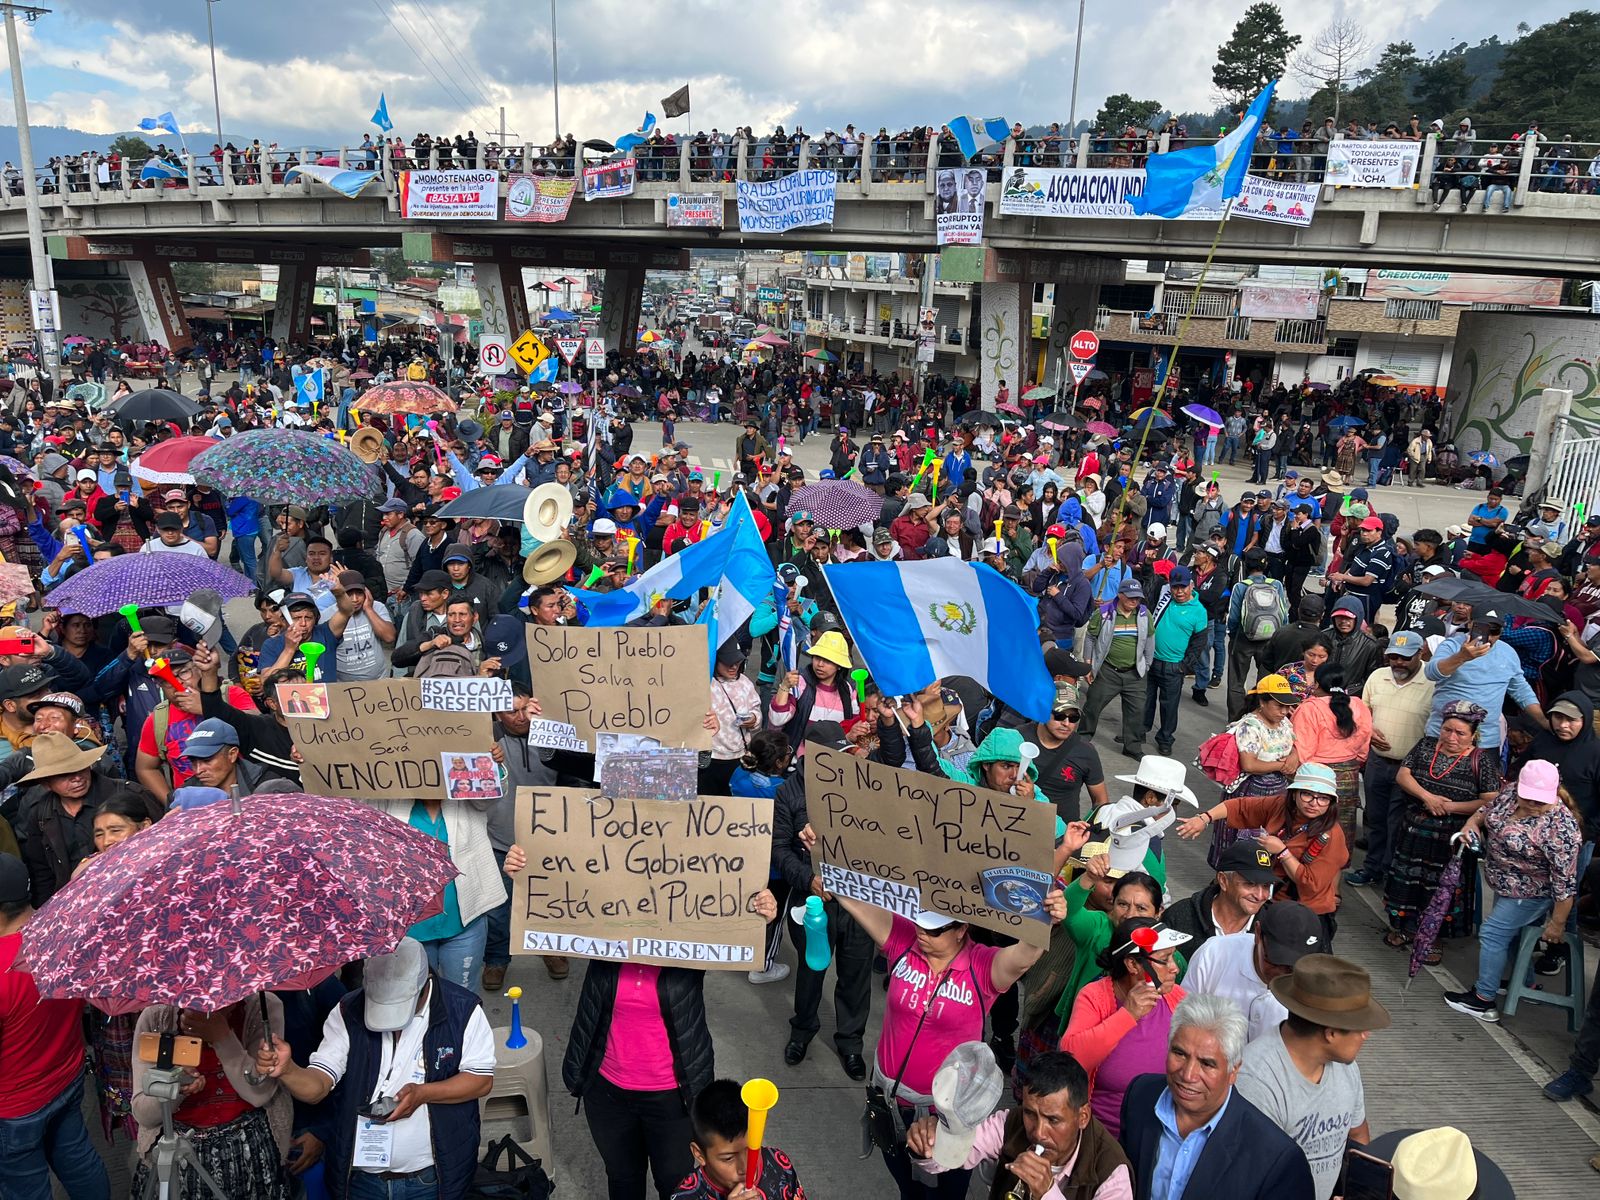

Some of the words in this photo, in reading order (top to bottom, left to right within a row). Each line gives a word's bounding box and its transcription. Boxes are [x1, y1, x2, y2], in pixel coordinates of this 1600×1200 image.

[1351, 158, 1399, 166] PRESENTES
[418, 173, 492, 183] MOMOSTENANGO
[750, 184, 758, 197] A
[760, 181, 777, 197] LOS
[1047, 175, 1118, 204] ASOCIACION
[1119, 175, 1146, 204] INDI
[1261, 178, 1281, 190] MATEO
[1353, 174, 1386, 183] LUCHA
[429, 193, 461, 203] ¡BASTA
[1051, 203, 1069, 215] SAN
[1072, 204, 1127, 216] FRANCISCO
[1251, 187, 1262, 197] CON
[1263, 189, 1275, 198] LOS
[1285, 191, 1316, 204] CANTONES
[684, 210, 713, 218] PRESENTE
[760, 289, 783, 300] Hola
[1073, 340, 1096, 350] ALTO
[534, 627, 578, 663] Solo
[586, 631, 601, 658] el
[614, 630, 676, 660] Pueblo
[578, 664, 634, 687] Salva
[647, 664, 664, 687] al
[344, 686, 423, 717] Pueblo
[422, 694, 512, 712] PRESENTE
[560, 689, 671, 730] Pueblo
[295, 717, 364, 746] Unido
[386, 717, 472, 742] Jamas
[529, 733, 585, 750] PRESENTE
[370, 741, 410, 756] Será
[313, 759, 441, 791] VENCIDO
[815, 752, 844, 787] Si
[855, 761, 882, 791] No
[895, 773, 939, 825] hay
[944, 787, 1031, 836] PAZ
[531, 792, 568, 835] El
[587, 795, 673, 839] Poder
[686, 801, 724, 838] NO
[727, 803, 772, 837] esta
[821, 793, 886, 835] Para
[896, 815, 923, 845] el
[935, 822, 1021, 862] Pueblo
[542, 854, 575, 872] en
[586, 844, 609, 873] el
[625, 840, 745, 880] Gobierno
[821, 835, 906, 881] Menos
[913, 870, 964, 894] para
[971, 872, 985, 897] el
[526, 875, 595, 920] Está
[601, 900, 632, 917] en
[637, 886, 658, 915] el
[660, 878, 760, 922] Pueblo
[823, 877, 919, 920] PRESENTE
[931, 889, 1022, 926] Gobierno
[526, 932, 627, 958] SALCAJÁ
[635, 938, 754, 962] PRESENTE
[1294, 1112, 1350, 1145] Moose
